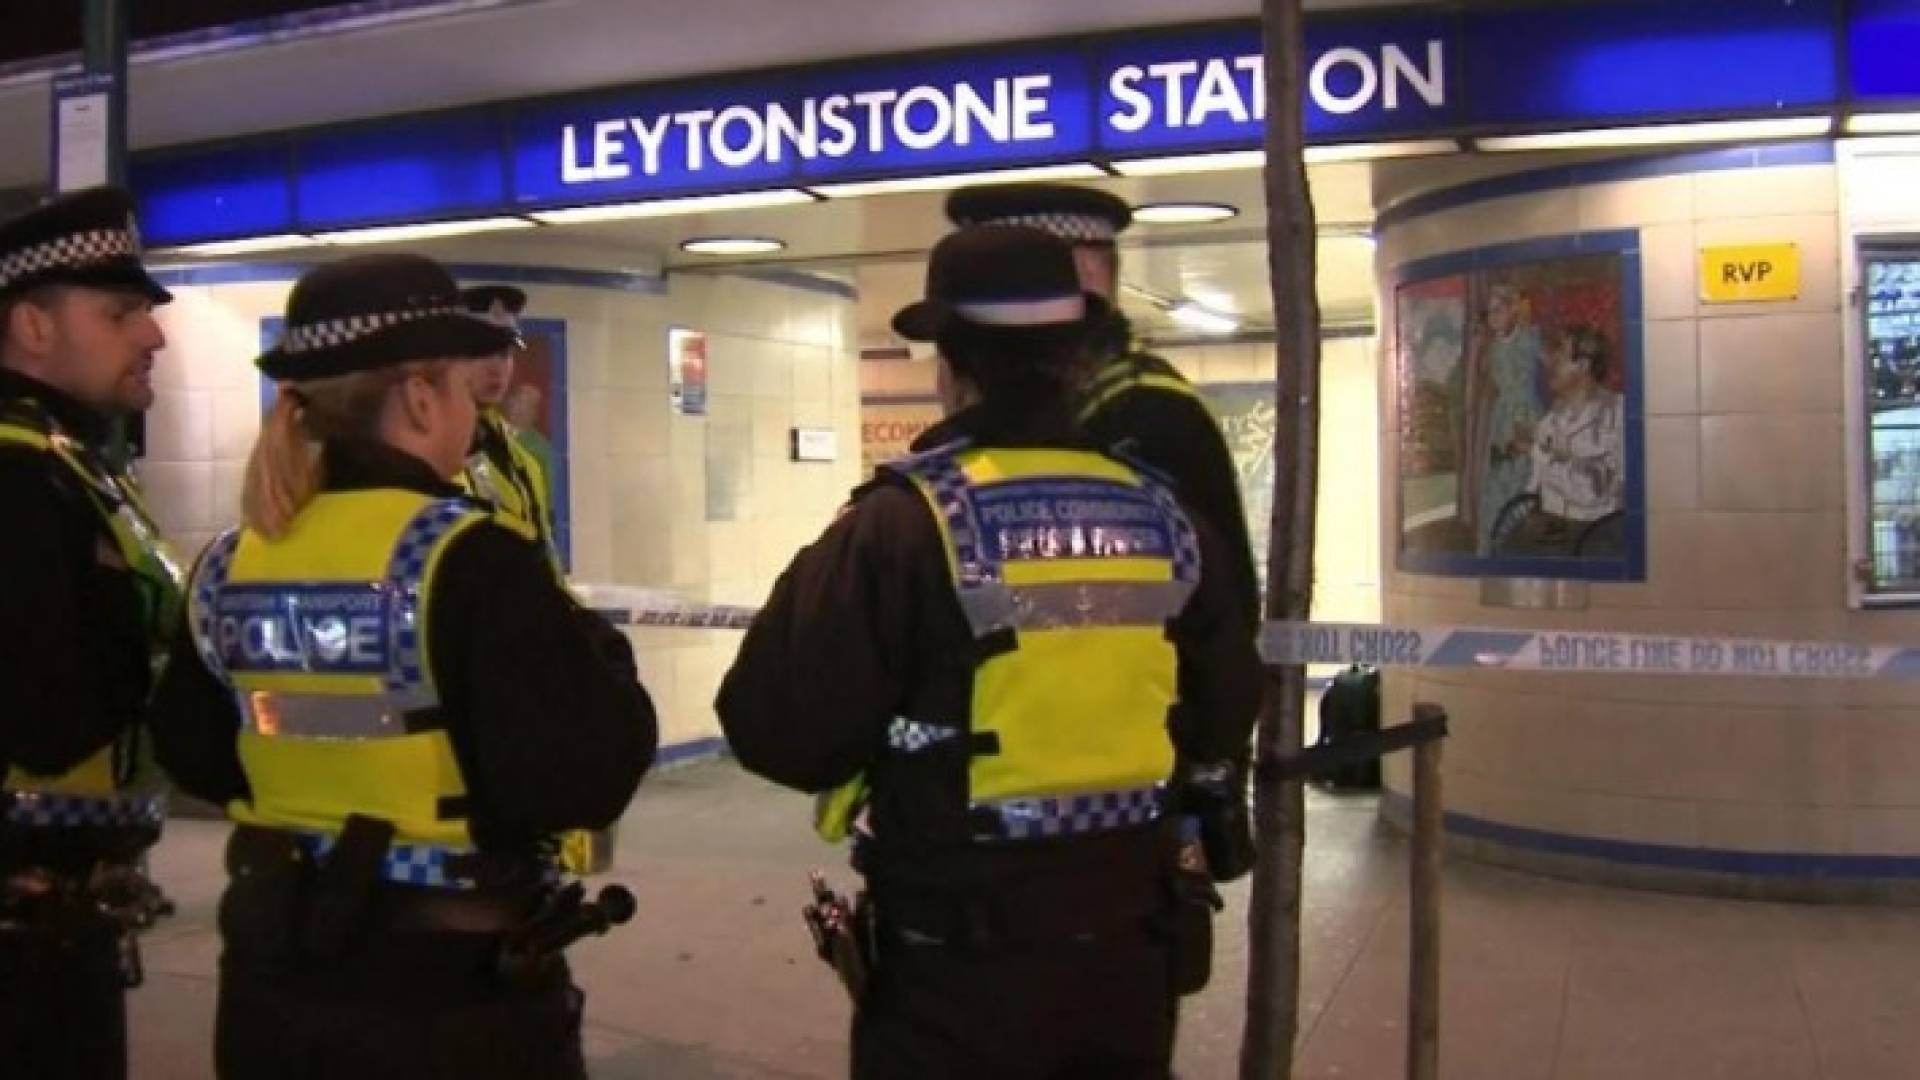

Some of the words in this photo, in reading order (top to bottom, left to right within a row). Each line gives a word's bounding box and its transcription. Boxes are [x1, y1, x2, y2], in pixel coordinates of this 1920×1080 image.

[561, 75, 1054, 184] LEYTONSTONE
[1108, 40, 1444, 132] STATON
[1722, 260, 1773, 284] RVP
[219, 615, 382, 662] POLICE
